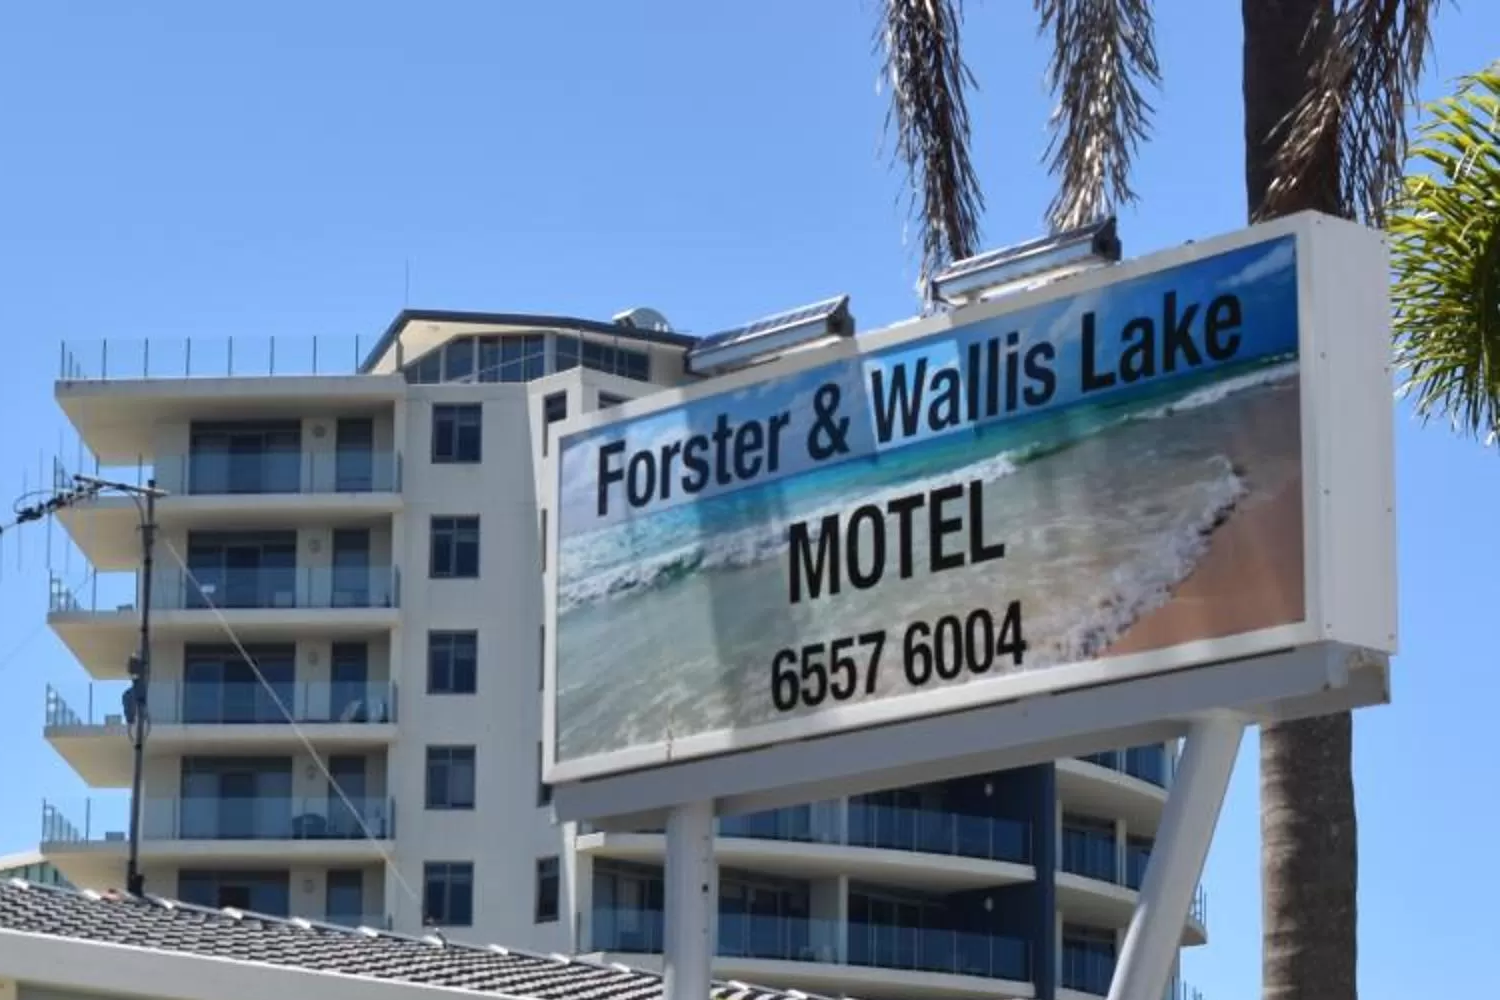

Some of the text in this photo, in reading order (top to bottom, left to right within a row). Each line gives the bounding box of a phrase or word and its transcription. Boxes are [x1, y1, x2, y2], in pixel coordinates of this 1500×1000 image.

[597, 291, 1243, 517] Forster & Wallis Lake
[788, 481, 1005, 604] MOTEL
[770, 602, 1026, 711] 6557 6004
